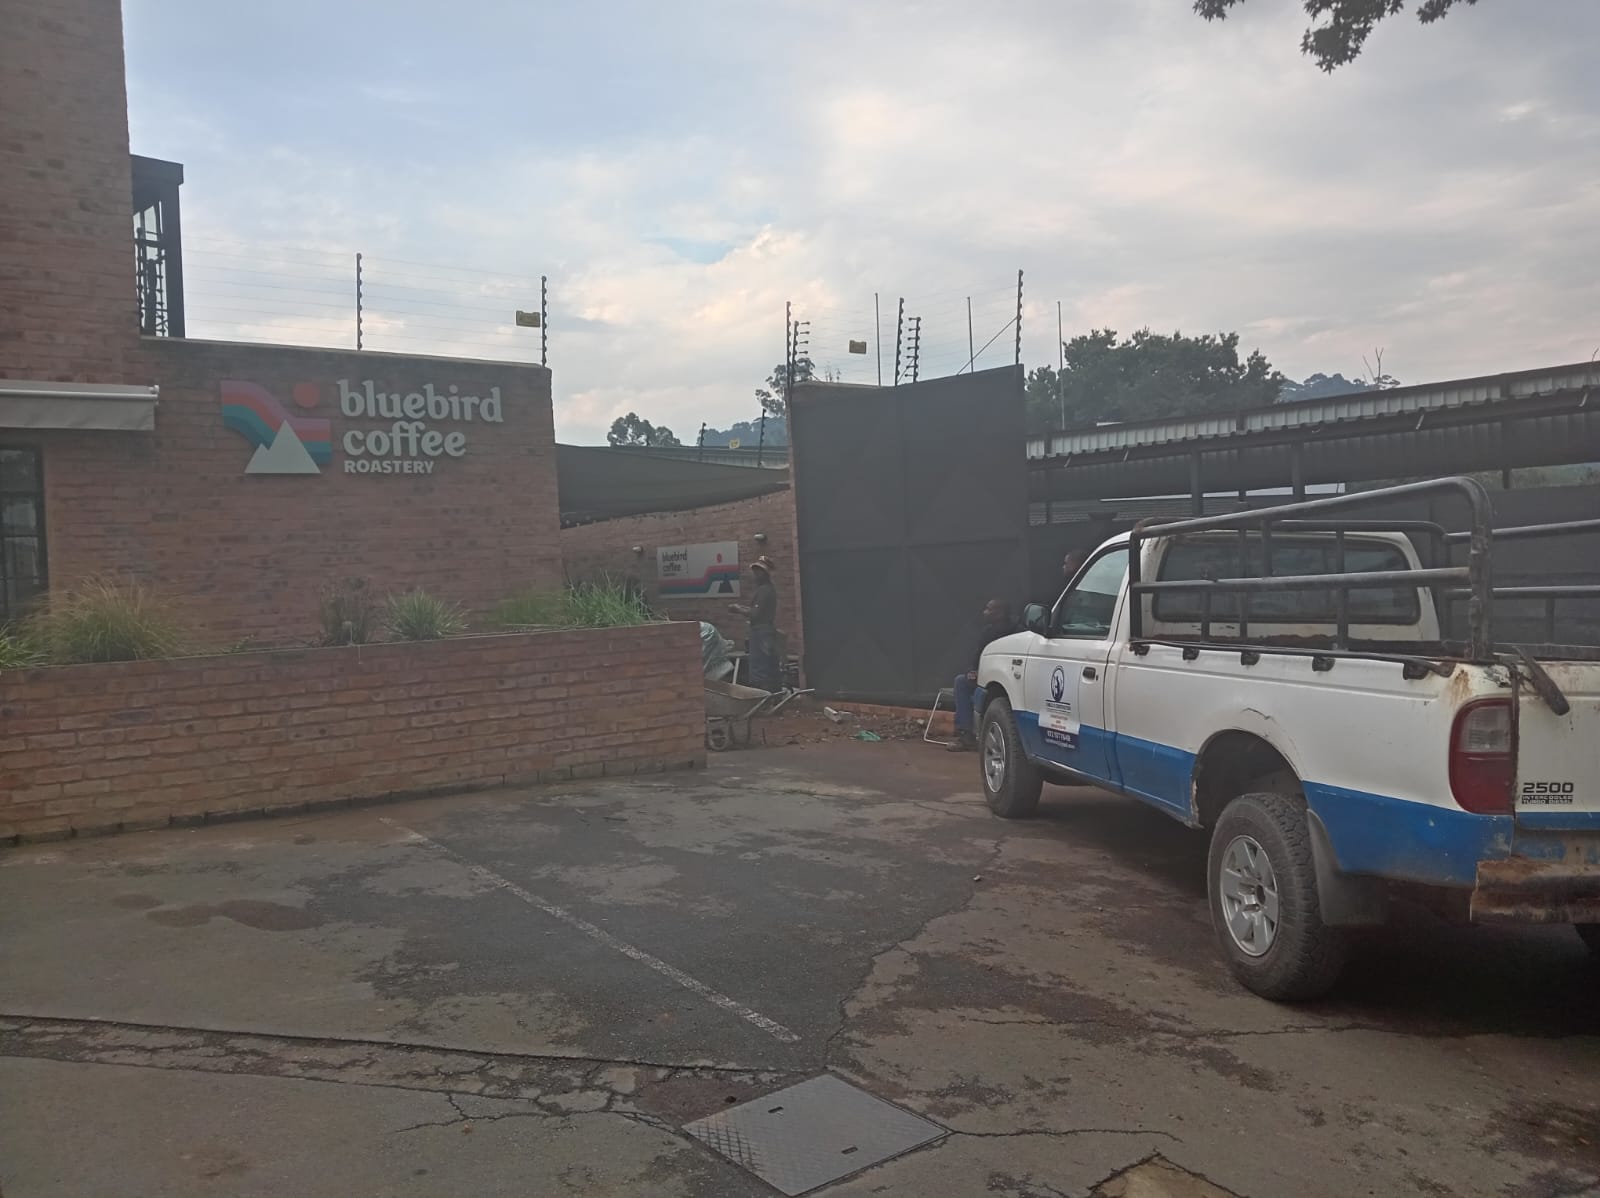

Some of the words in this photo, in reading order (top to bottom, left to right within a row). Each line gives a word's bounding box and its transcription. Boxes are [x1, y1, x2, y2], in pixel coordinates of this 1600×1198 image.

[337, 379, 504, 423] bluebird
[343, 421, 467, 457] coffee
[344, 460, 434, 474] ROASTERY
[1522, 782, 1574, 794] 2500
